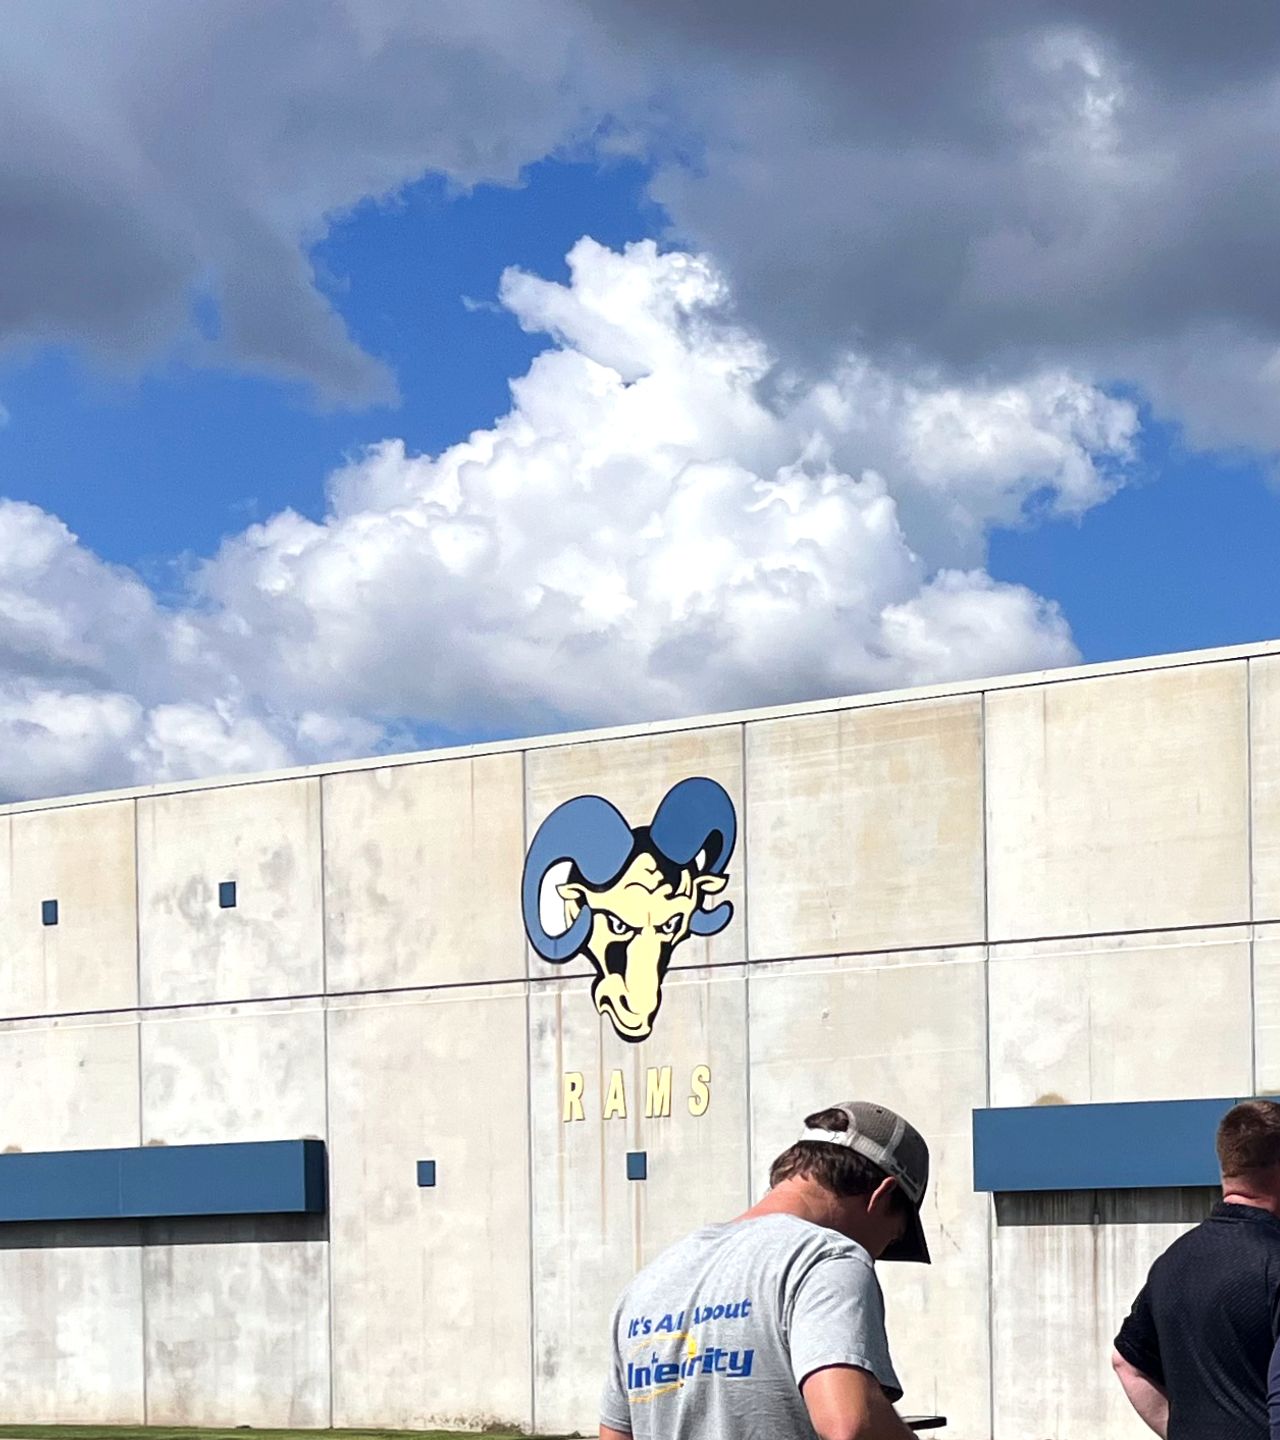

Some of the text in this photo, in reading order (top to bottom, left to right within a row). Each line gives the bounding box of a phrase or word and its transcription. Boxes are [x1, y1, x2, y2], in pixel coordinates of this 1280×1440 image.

[563, 1064, 711, 1122] RAMS
[627, 1316, 652, 1339] It's
[654, 1311, 685, 1333] Al
[627, 1347, 754, 1389] Interity
